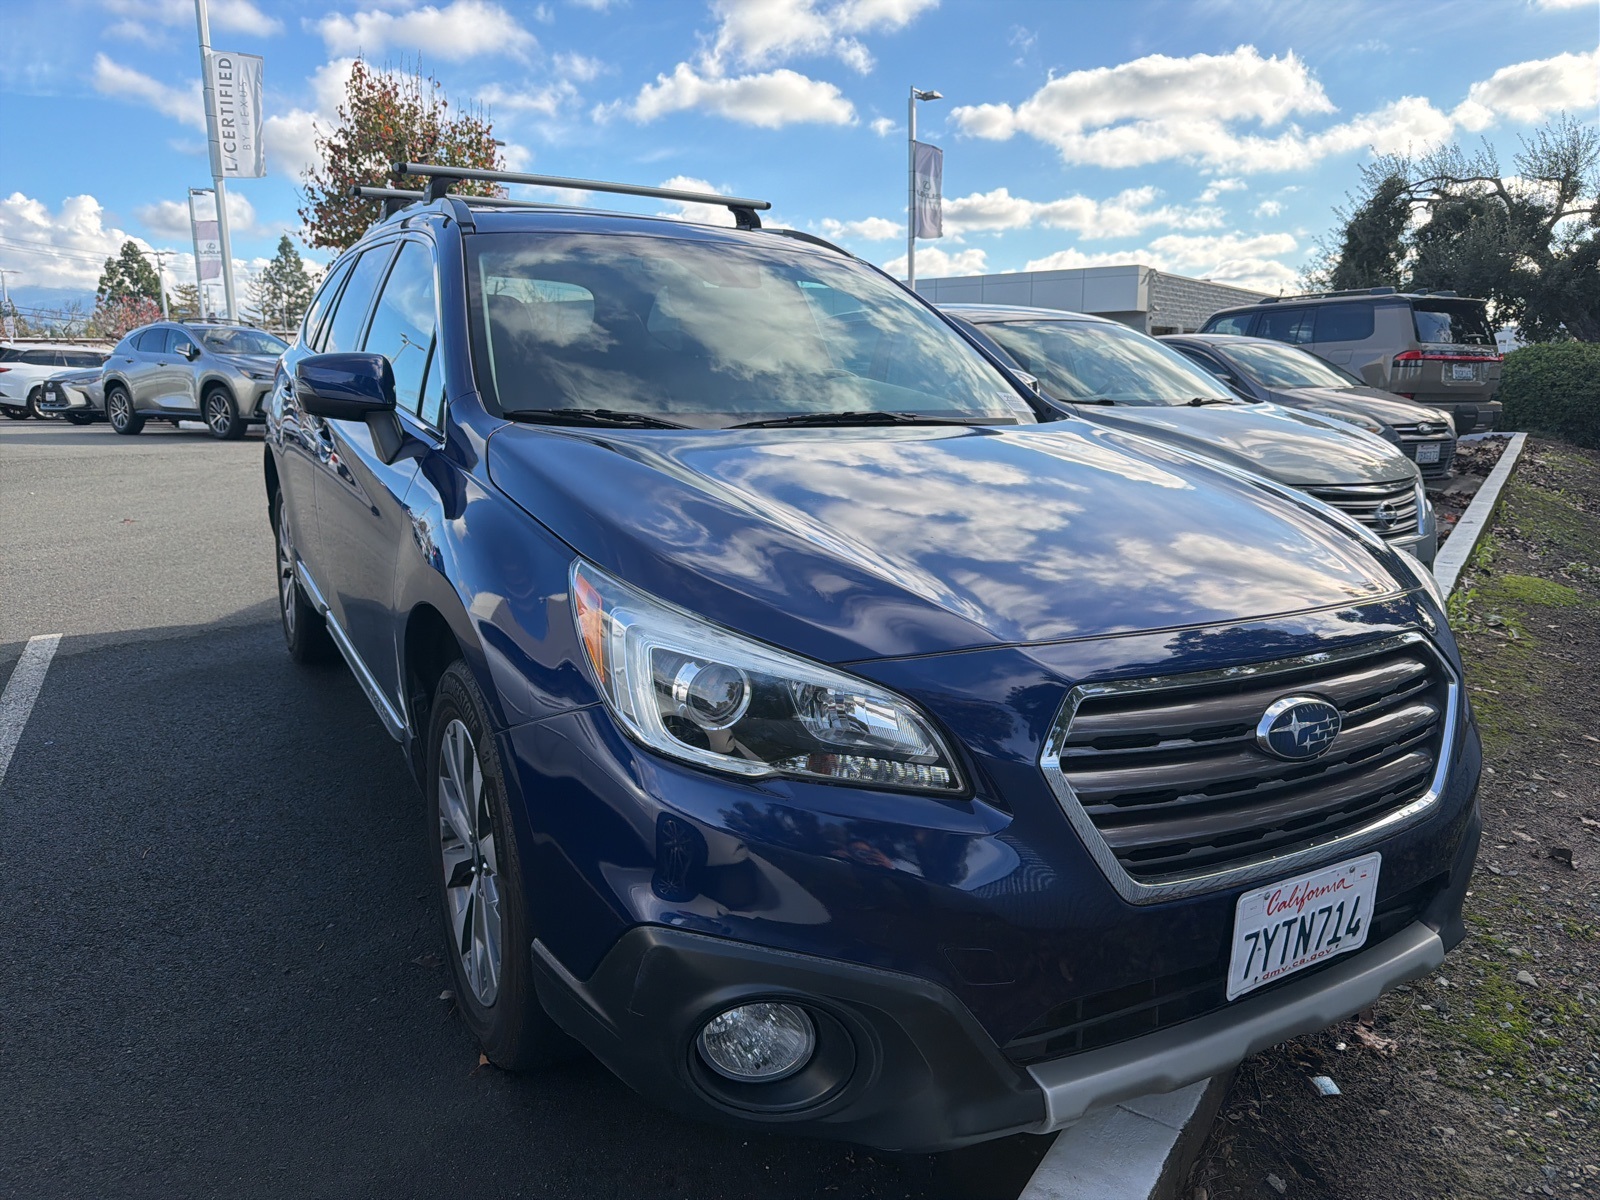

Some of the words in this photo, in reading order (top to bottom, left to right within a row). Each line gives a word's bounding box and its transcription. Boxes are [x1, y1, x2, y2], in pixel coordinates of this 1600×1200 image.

[218, 57, 239, 172] L/CERTIFIED
[238, 80, 250, 126] LEXUS
[242, 135, 252, 151] BY
[1266, 877, 1353, 916] California
[1242, 895, 1362, 981] 7YTN714
[1262, 947, 1333, 980] dmv.ca.gov
